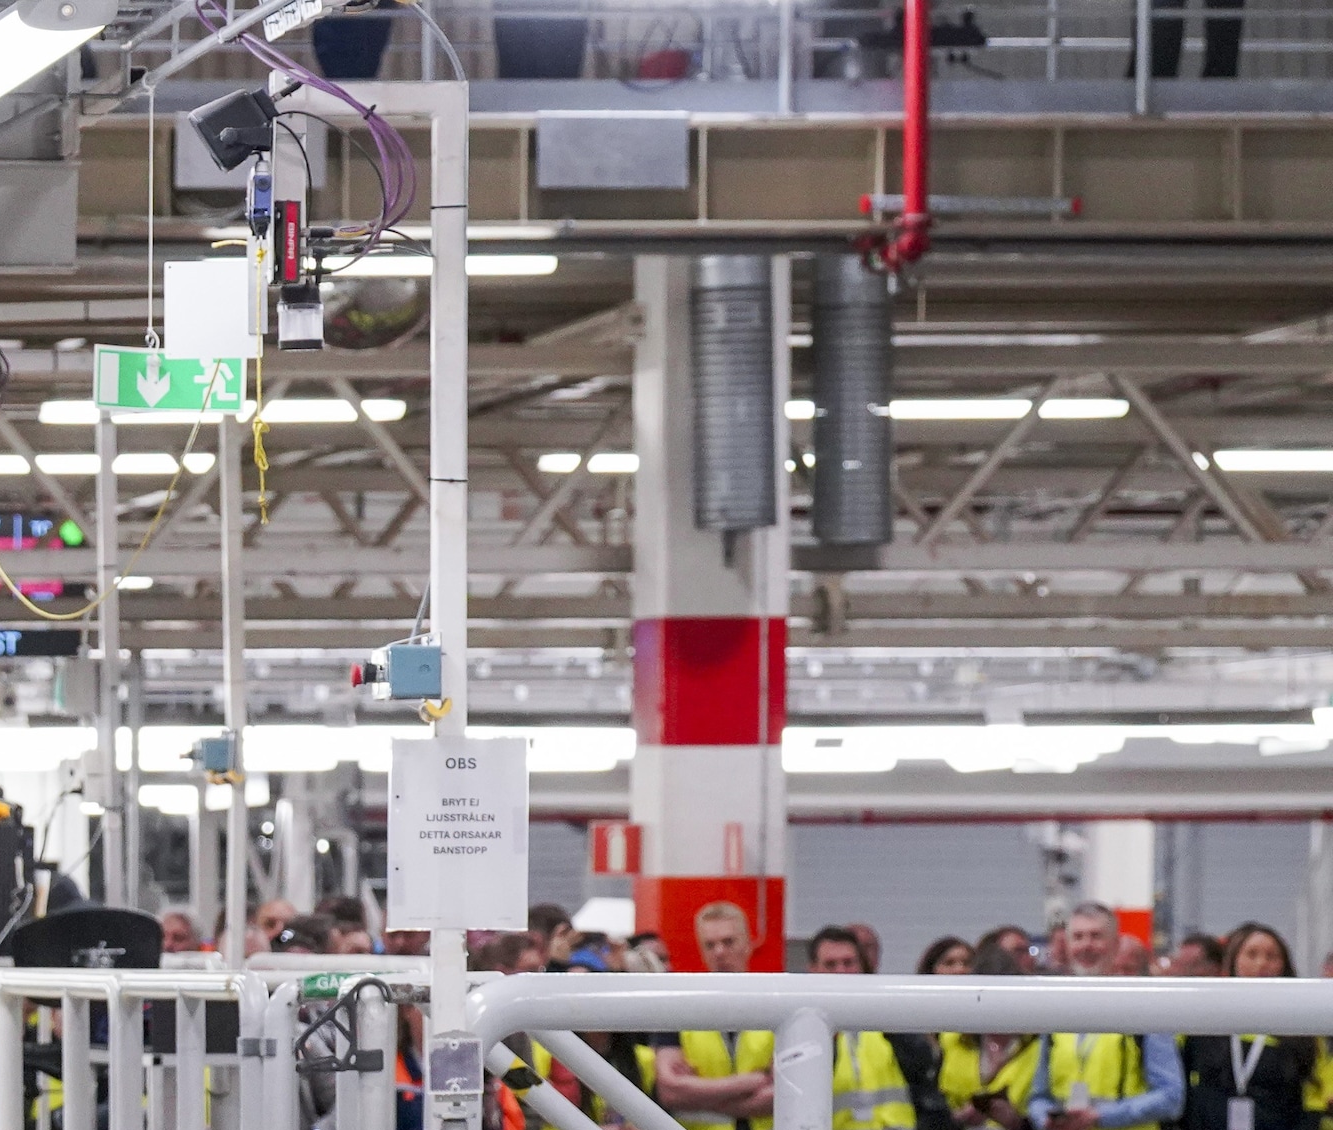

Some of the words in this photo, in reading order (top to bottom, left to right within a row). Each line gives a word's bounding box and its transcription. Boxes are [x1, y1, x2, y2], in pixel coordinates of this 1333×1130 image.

[445, 757, 477, 770] OBS
[441, 797, 467, 807] BRYT
[469, 797, 480, 807] EJ
[425, 811, 496, 823] LJUSSTRÅLEN
[419, 830, 451, 840] DETTA
[452, 830, 502, 840] ORSAKAR
[433, 845, 488, 855] BANSTOPP
